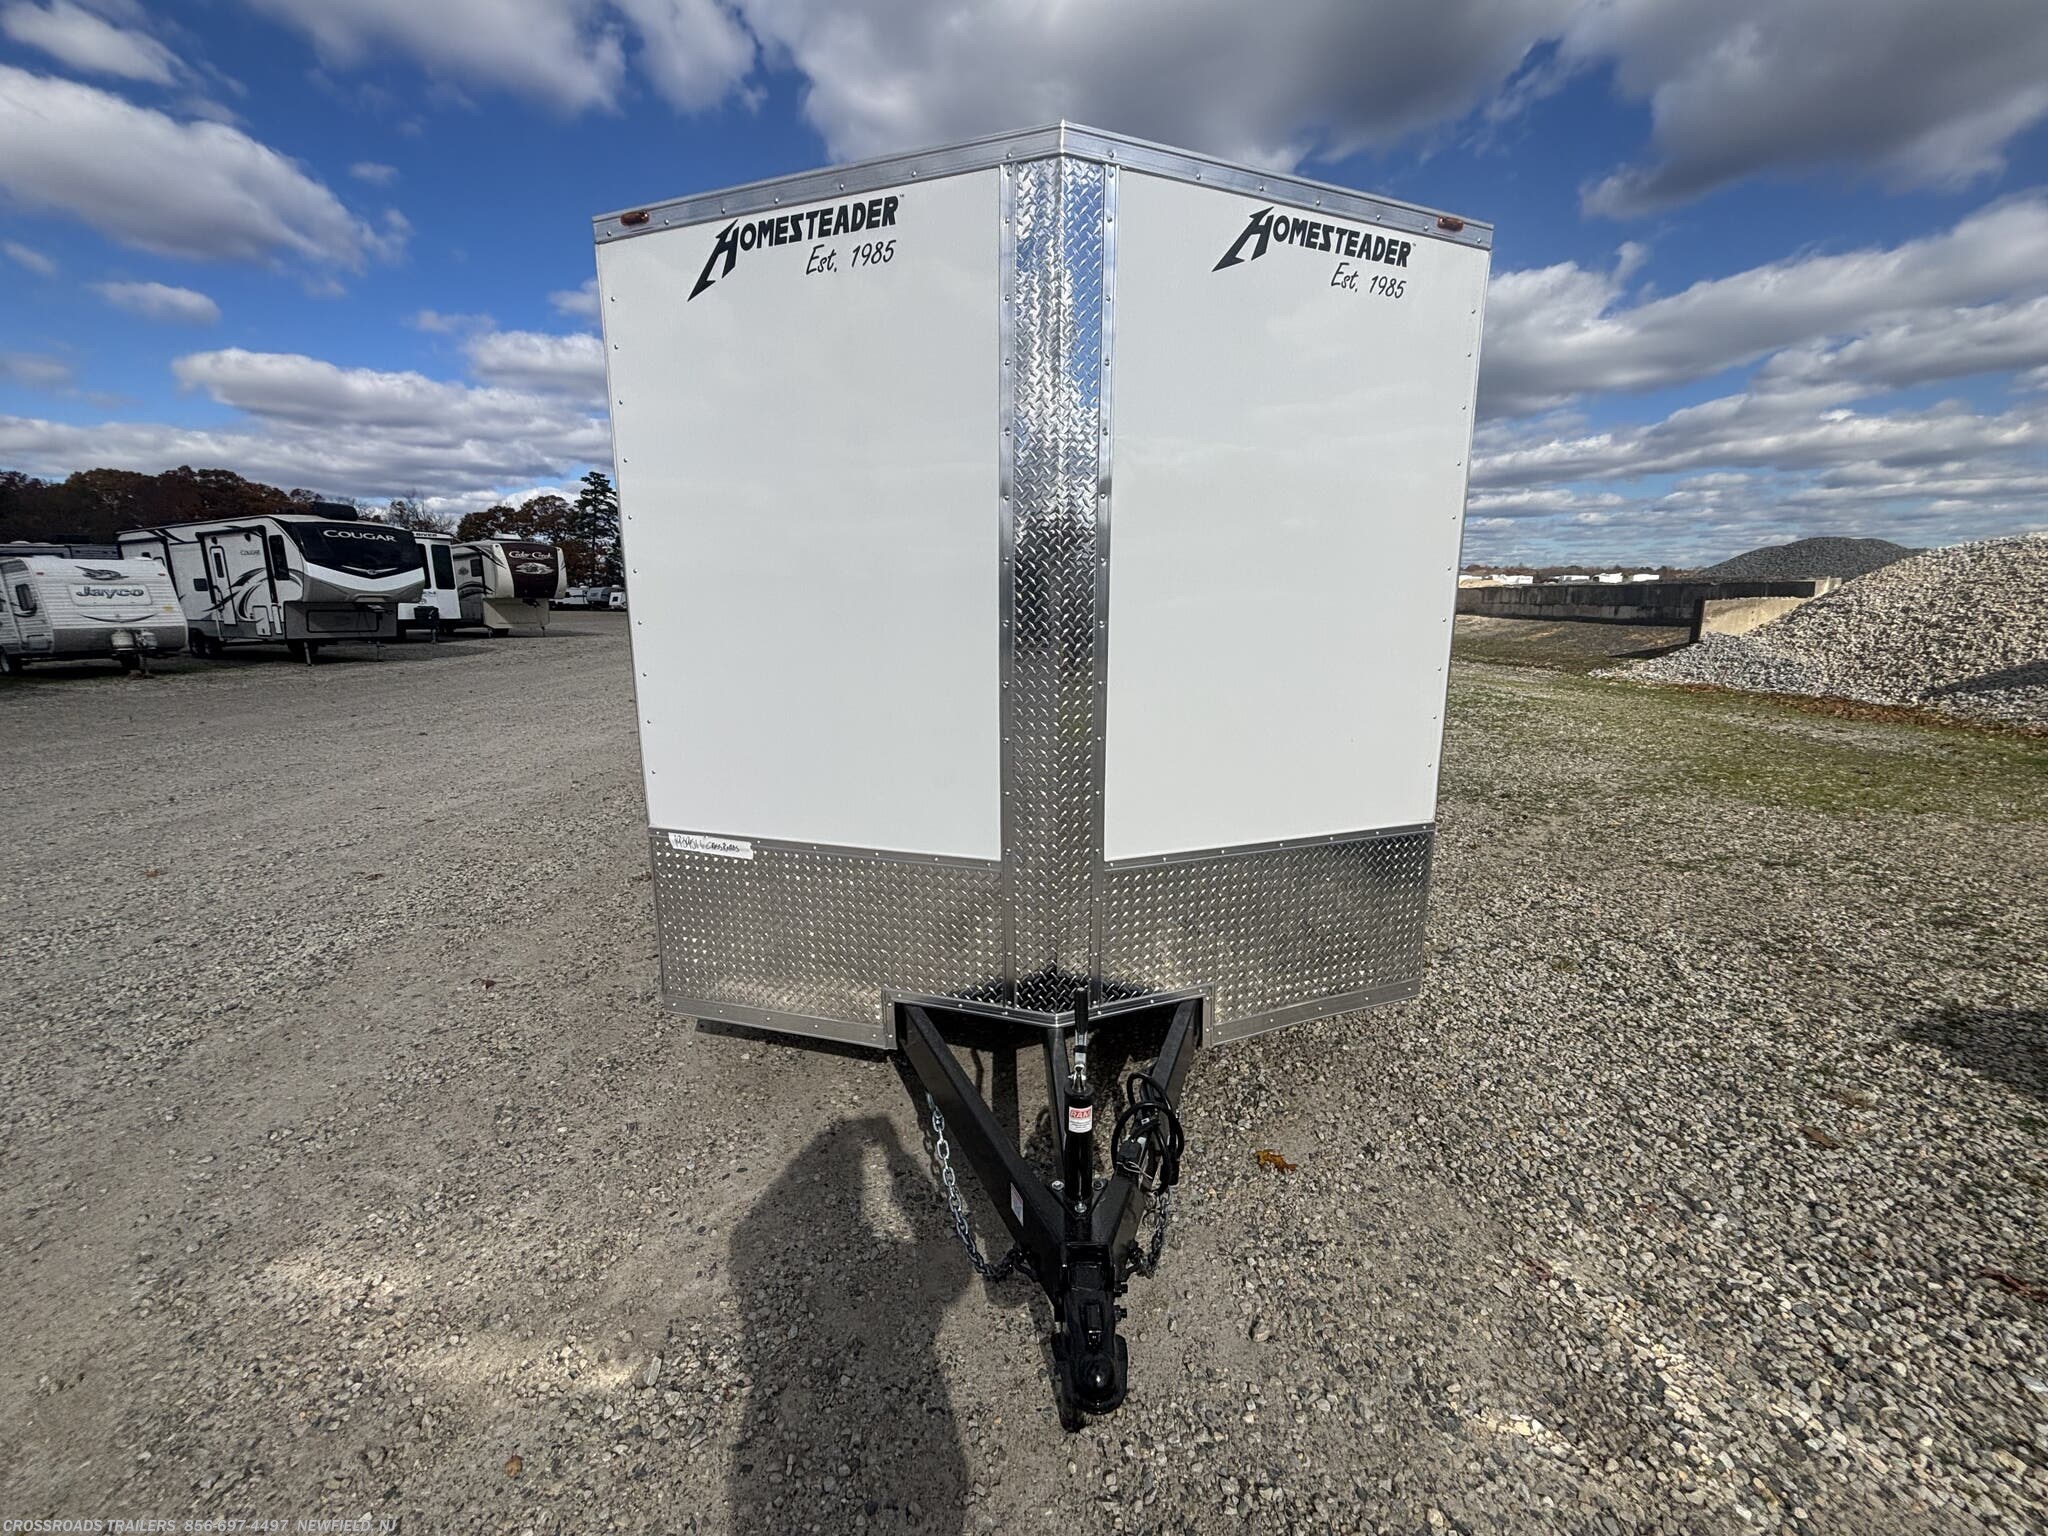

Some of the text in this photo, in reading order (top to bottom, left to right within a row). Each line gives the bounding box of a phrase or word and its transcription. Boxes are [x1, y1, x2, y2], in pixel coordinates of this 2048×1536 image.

[687, 195, 900, 302] HOMESTEADER
[805, 239, 897, 275] Est. 1985
[1211, 206, 1412, 272] HOMESTEADER
[1330, 262, 1407, 299] Est. 1985
[323, 529, 397, 542] COUGAR
[76, 586, 144, 599] Jayco
